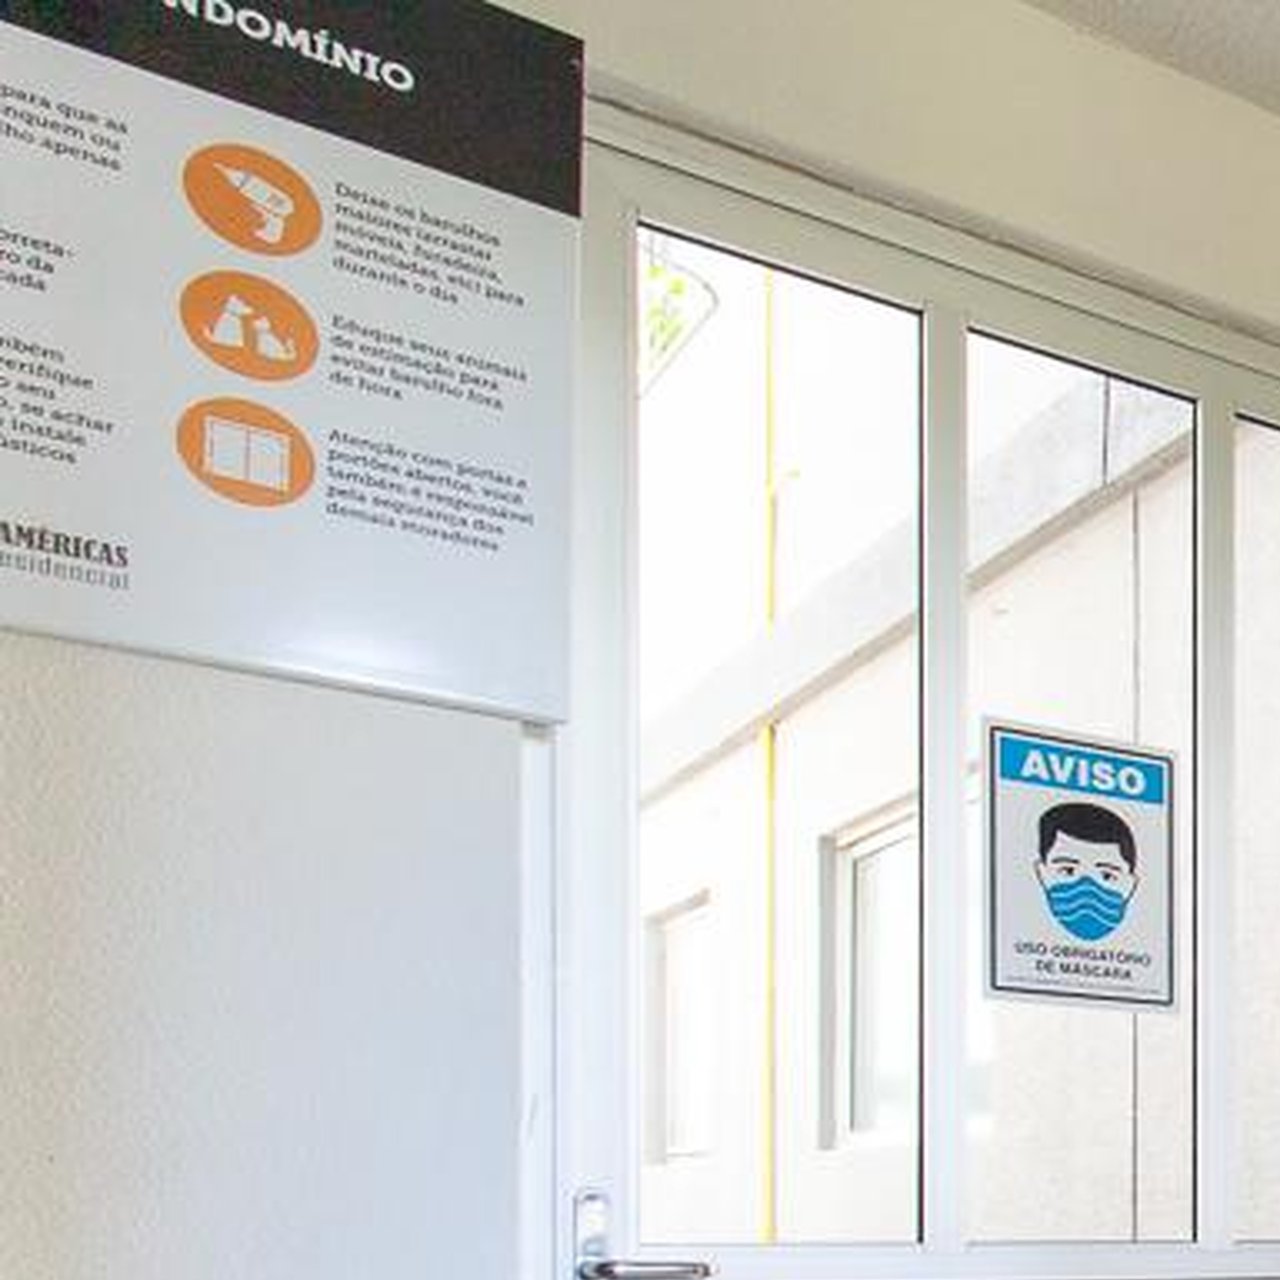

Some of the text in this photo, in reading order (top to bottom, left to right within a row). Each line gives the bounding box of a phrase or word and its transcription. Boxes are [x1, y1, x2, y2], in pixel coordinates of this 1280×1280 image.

[0, 356, 95, 388] erifique
[1020, 748, 1146, 795] AVISO
[1014, 942, 1047, 956] USO
[1035, 959, 1057, 975] DE
